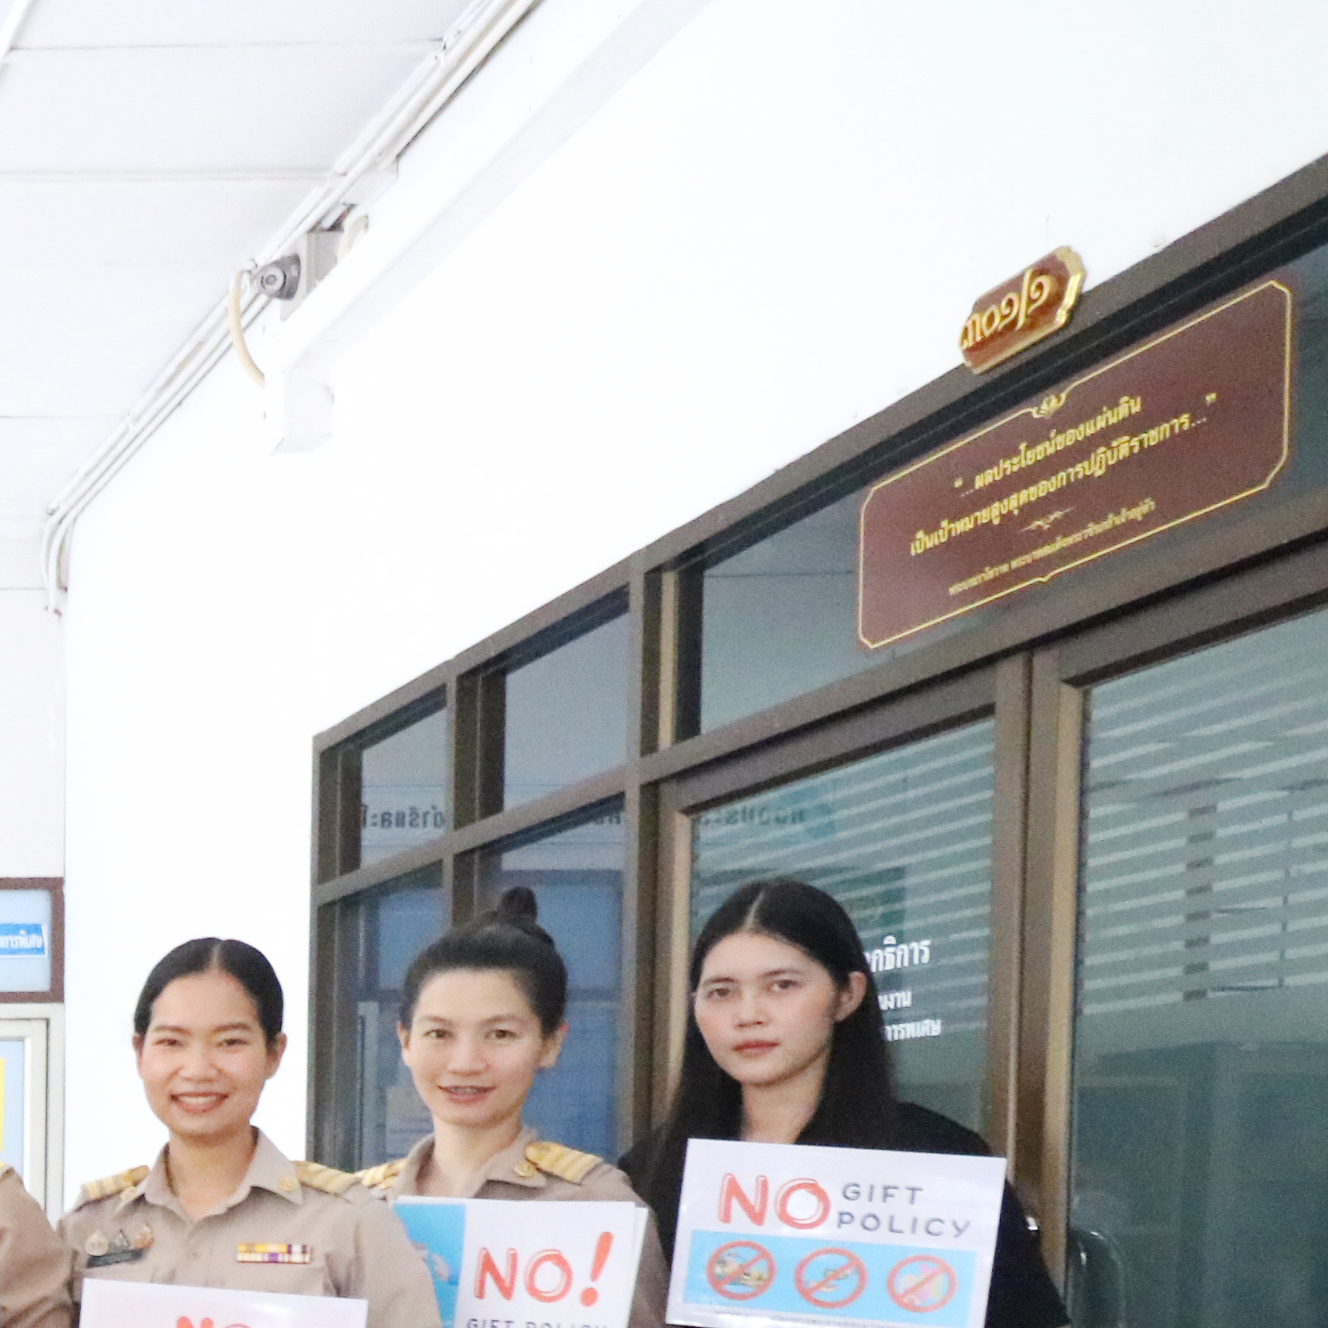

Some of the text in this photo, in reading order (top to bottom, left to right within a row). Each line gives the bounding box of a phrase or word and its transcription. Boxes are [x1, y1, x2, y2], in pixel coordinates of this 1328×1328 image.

[718, 1172, 924, 1230] NO GIFT
[836, 1211, 972, 1239] POLICY
[474, 1231, 614, 1307] NO!
